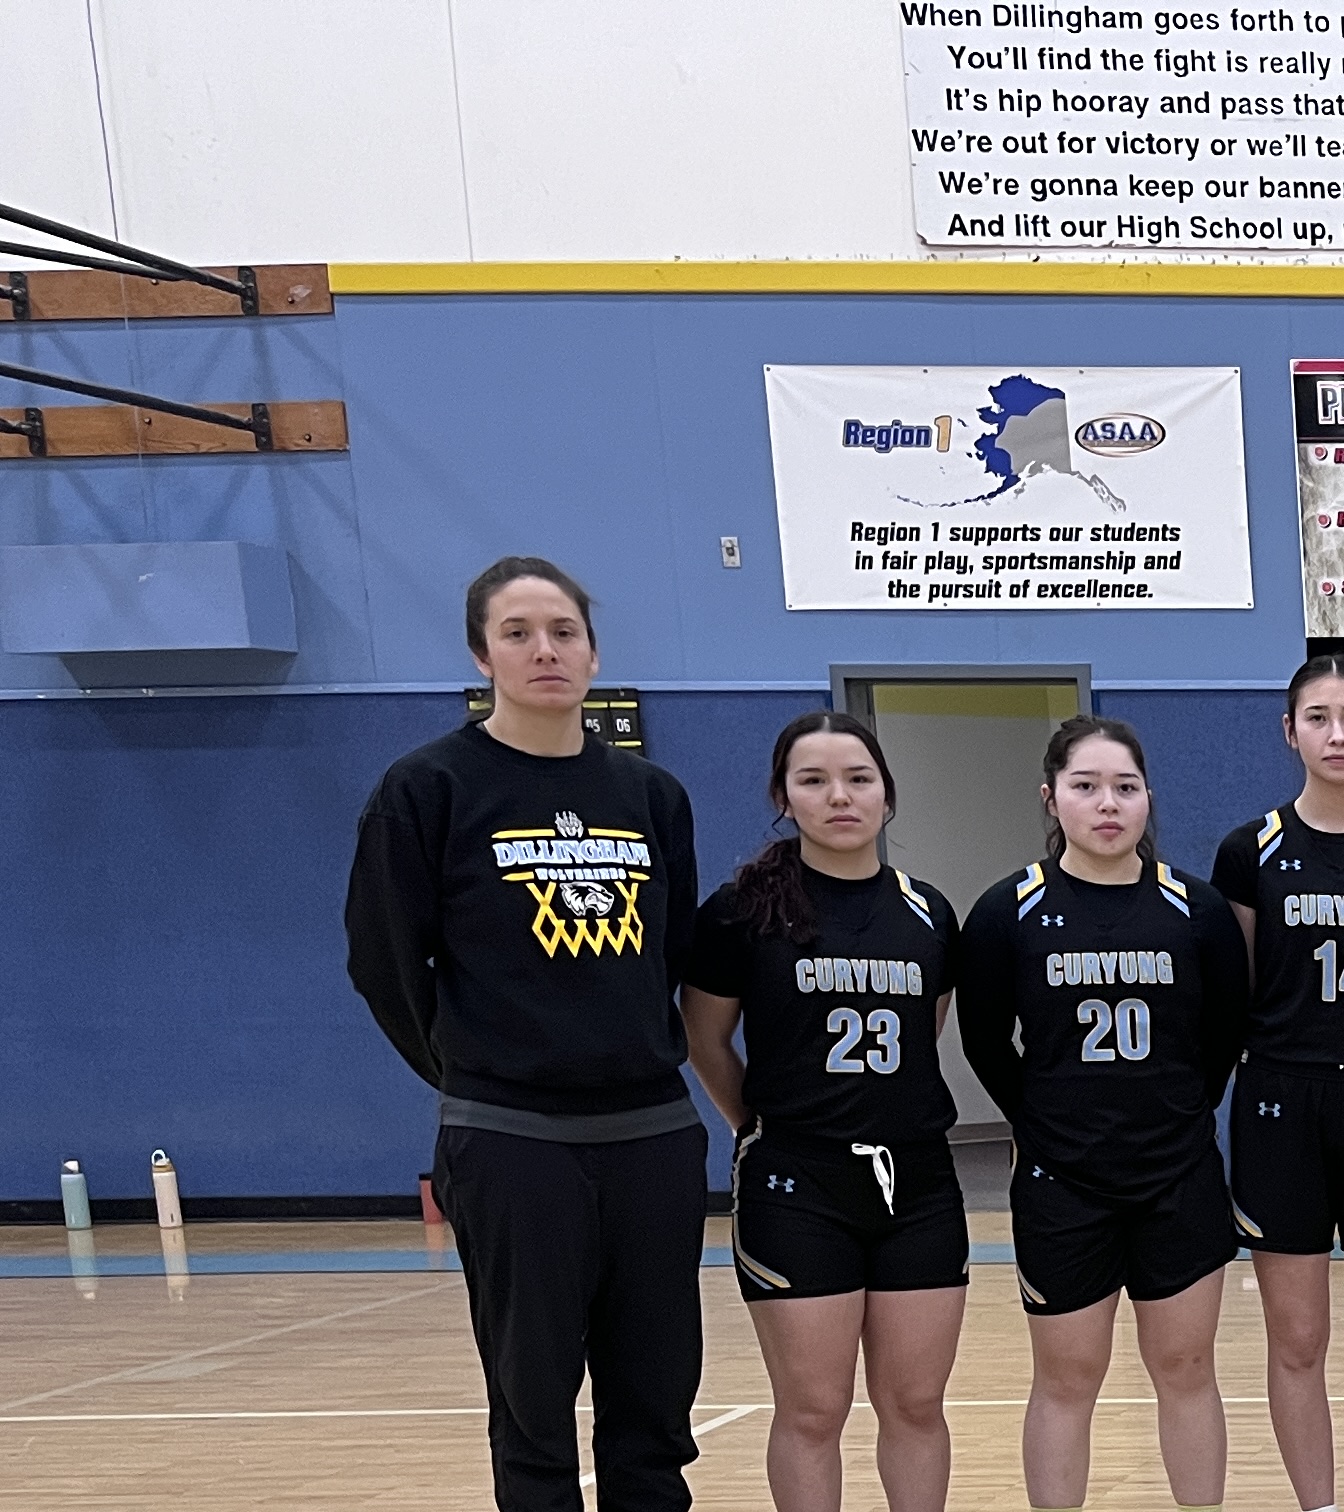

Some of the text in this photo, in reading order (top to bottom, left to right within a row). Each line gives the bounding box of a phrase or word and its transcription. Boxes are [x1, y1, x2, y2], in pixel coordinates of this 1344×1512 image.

[901, 3, 981, 26] When
[993, 3, 1143, 33] Dillingham
[1155, 12, 1220, 35] goes
[1231, 9, 1294, 32] forth
[1304, 13, 1330, 33] to
[1038, 47, 1091, 71] find
[1101, 49, 1144, 71] the
[1154, 49, 1217, 77] fight
[1226, 50, 1248, 73] is
[1260, 51, 1331, 80] really
[999, 89, 1042, 117] hip
[1052, 89, 1149, 118] hooray
[1160, 91, 1210, 114] and
[1221, 96, 1284, 119] pass
[1002, 132, 1048, 154] out
[1057, 131, 1097, 154] for
[1105, 131, 1200, 161] victory
[1210, 138, 1237, 156] or
[1030, 177, 1118, 201] gonna
[1129, 174, 1194, 203] keep
[1205, 180, 1249, 199] our
[947, 214, 1004, 237] And
[1015, 214, 1051, 237] lift
[1060, 219, 1107, 238] our
[1118, 215, 1179, 243] High
[1190, 216, 1282, 239] School
[1293, 222, 1334, 245] up,
[842, 415, 953, 454] Region 1
[1082, 422, 1158, 440] ASAA
[849, 522, 1181, 546] Region 1 supports our students
[855, 551, 1182, 575] in fair play, sportsmanship and
[888, 579, 1154, 603] the pursuit of excellence.
[616, 718, 631, 733] 06
[492, 839, 652, 868] DILLINGHAM
[795, 957, 923, 996] CURYUNG
[1046, 951, 1174, 987] CURYUNG
[825, 1007, 901, 1075] 23
[1077, 998, 1151, 1063] 20
